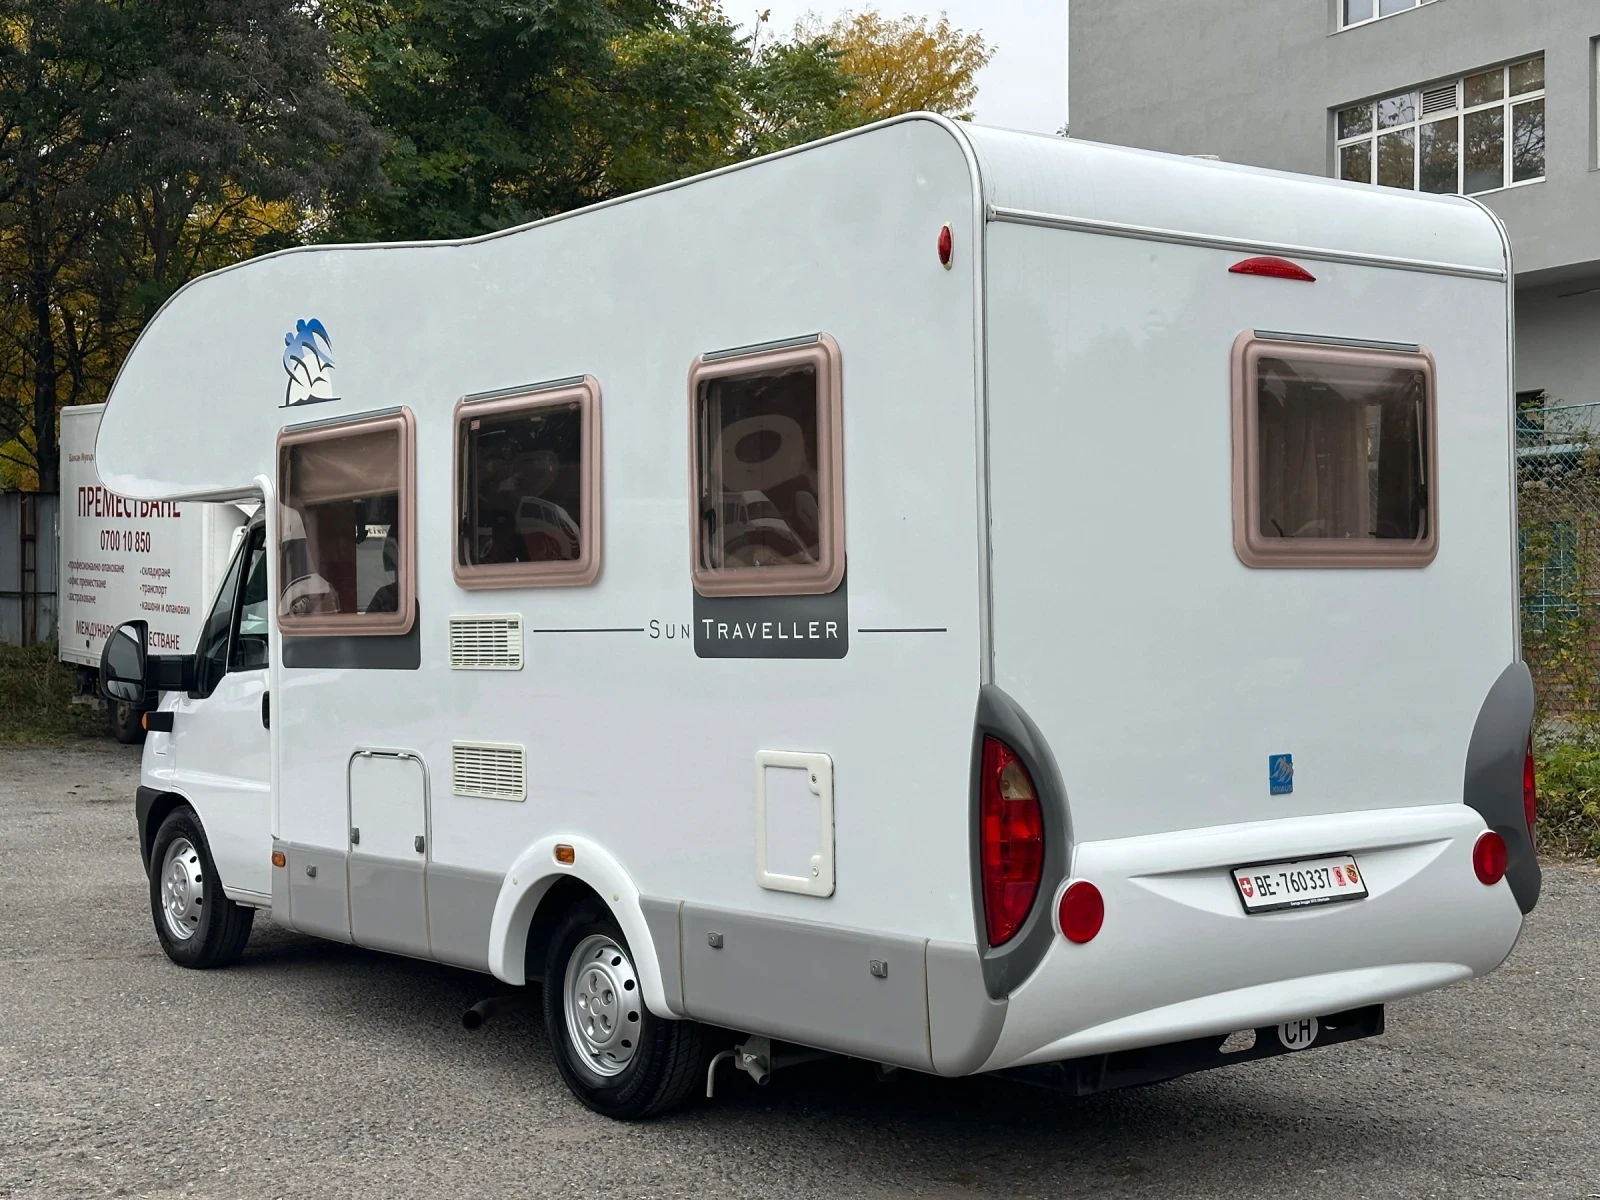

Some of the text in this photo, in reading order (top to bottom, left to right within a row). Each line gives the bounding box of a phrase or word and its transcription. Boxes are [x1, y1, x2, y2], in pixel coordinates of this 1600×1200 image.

[100, 530, 151, 553] 0700 10 850
[702, 618, 838, 639] TRAVELLER
[148, 631, 180, 650] ЕСТВАНЕ
[1284, 1019, 1311, 1044] CH
